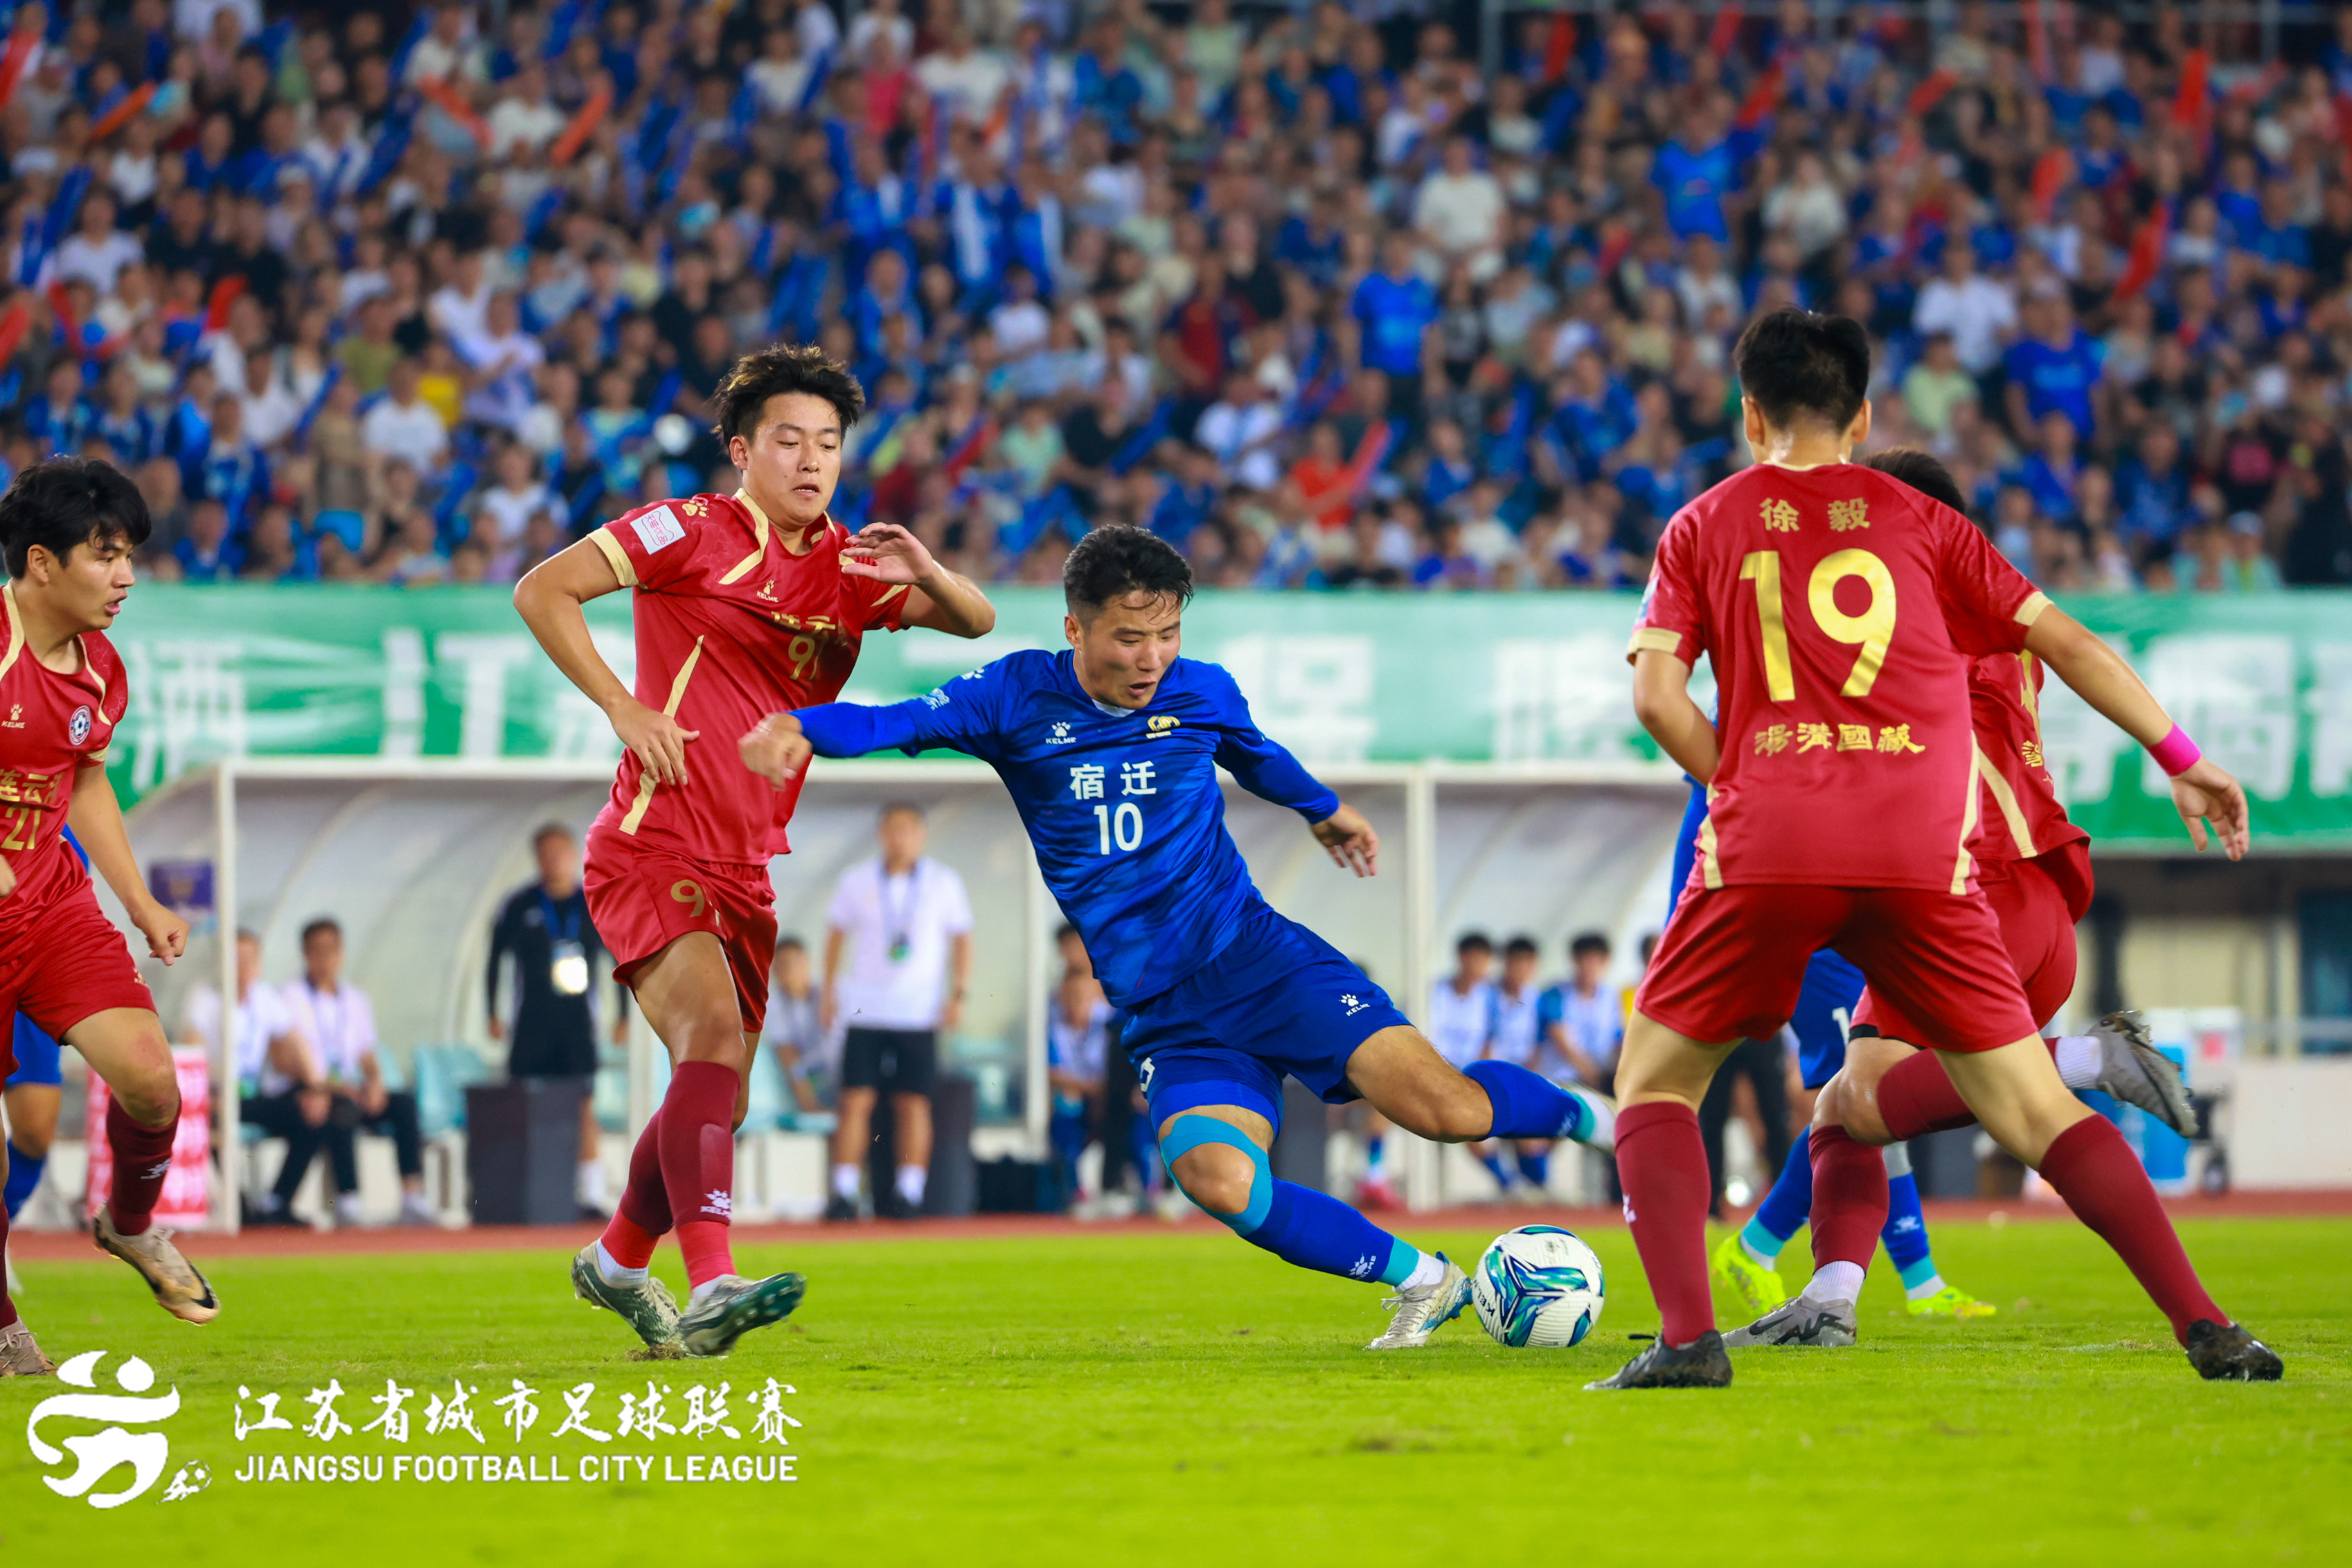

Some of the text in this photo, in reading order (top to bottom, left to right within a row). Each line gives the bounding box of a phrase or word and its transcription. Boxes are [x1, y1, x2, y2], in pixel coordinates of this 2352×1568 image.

[1760, 498, 1870, 532] 徐毅
[756, 591, 779, 603] KELME
[1739, 548, 1897, 702] 19
[1, 720, 26, 729] KELME
[1069, 760, 1157, 800] 宿迁
[1, 808, 41, 850] 21
[1094, 802, 1143, 855] 10
[1346, 1003, 1371, 1017] KELME
